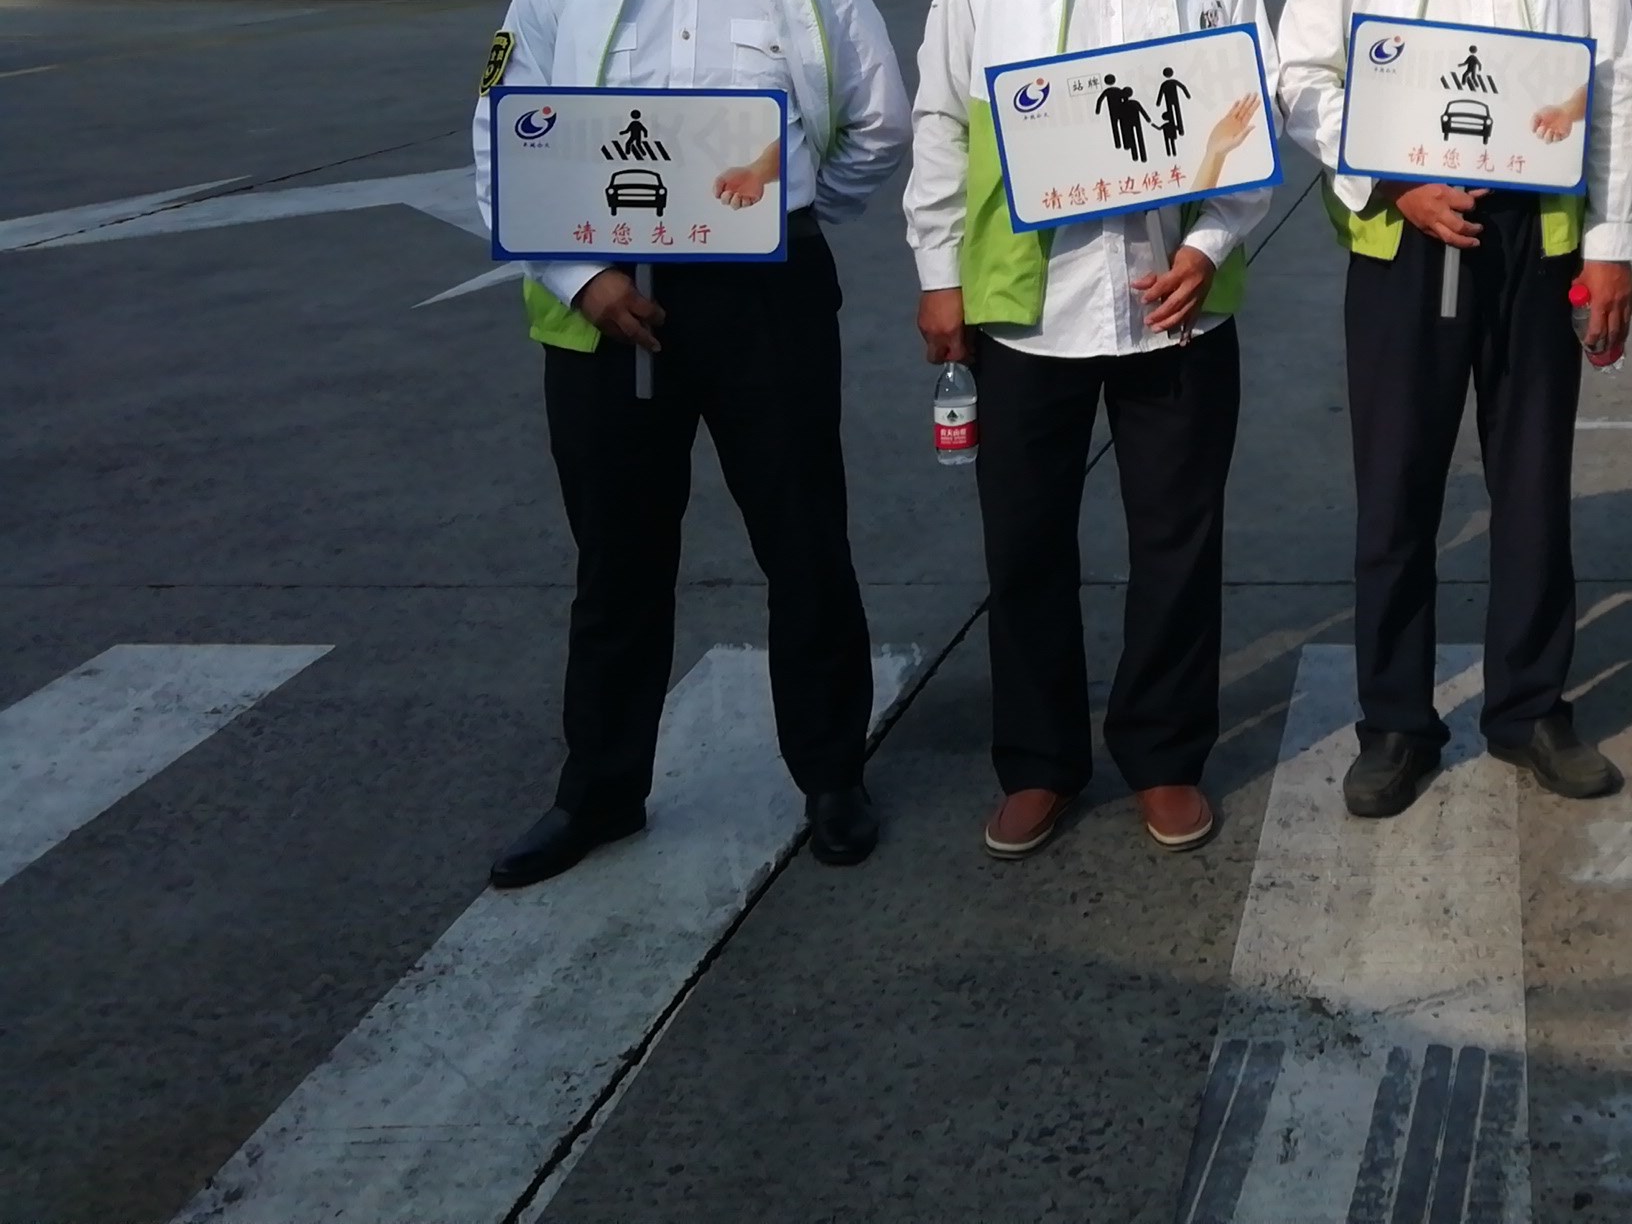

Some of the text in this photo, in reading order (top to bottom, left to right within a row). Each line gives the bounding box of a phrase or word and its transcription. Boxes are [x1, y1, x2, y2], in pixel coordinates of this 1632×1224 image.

[1072, 76, 1100, 92] 站牌
[1408, 144, 1528, 174] 请您先行
[1041, 164, 1188, 211] 请您靠边候车
[572, 220, 712, 246] 请您先行
